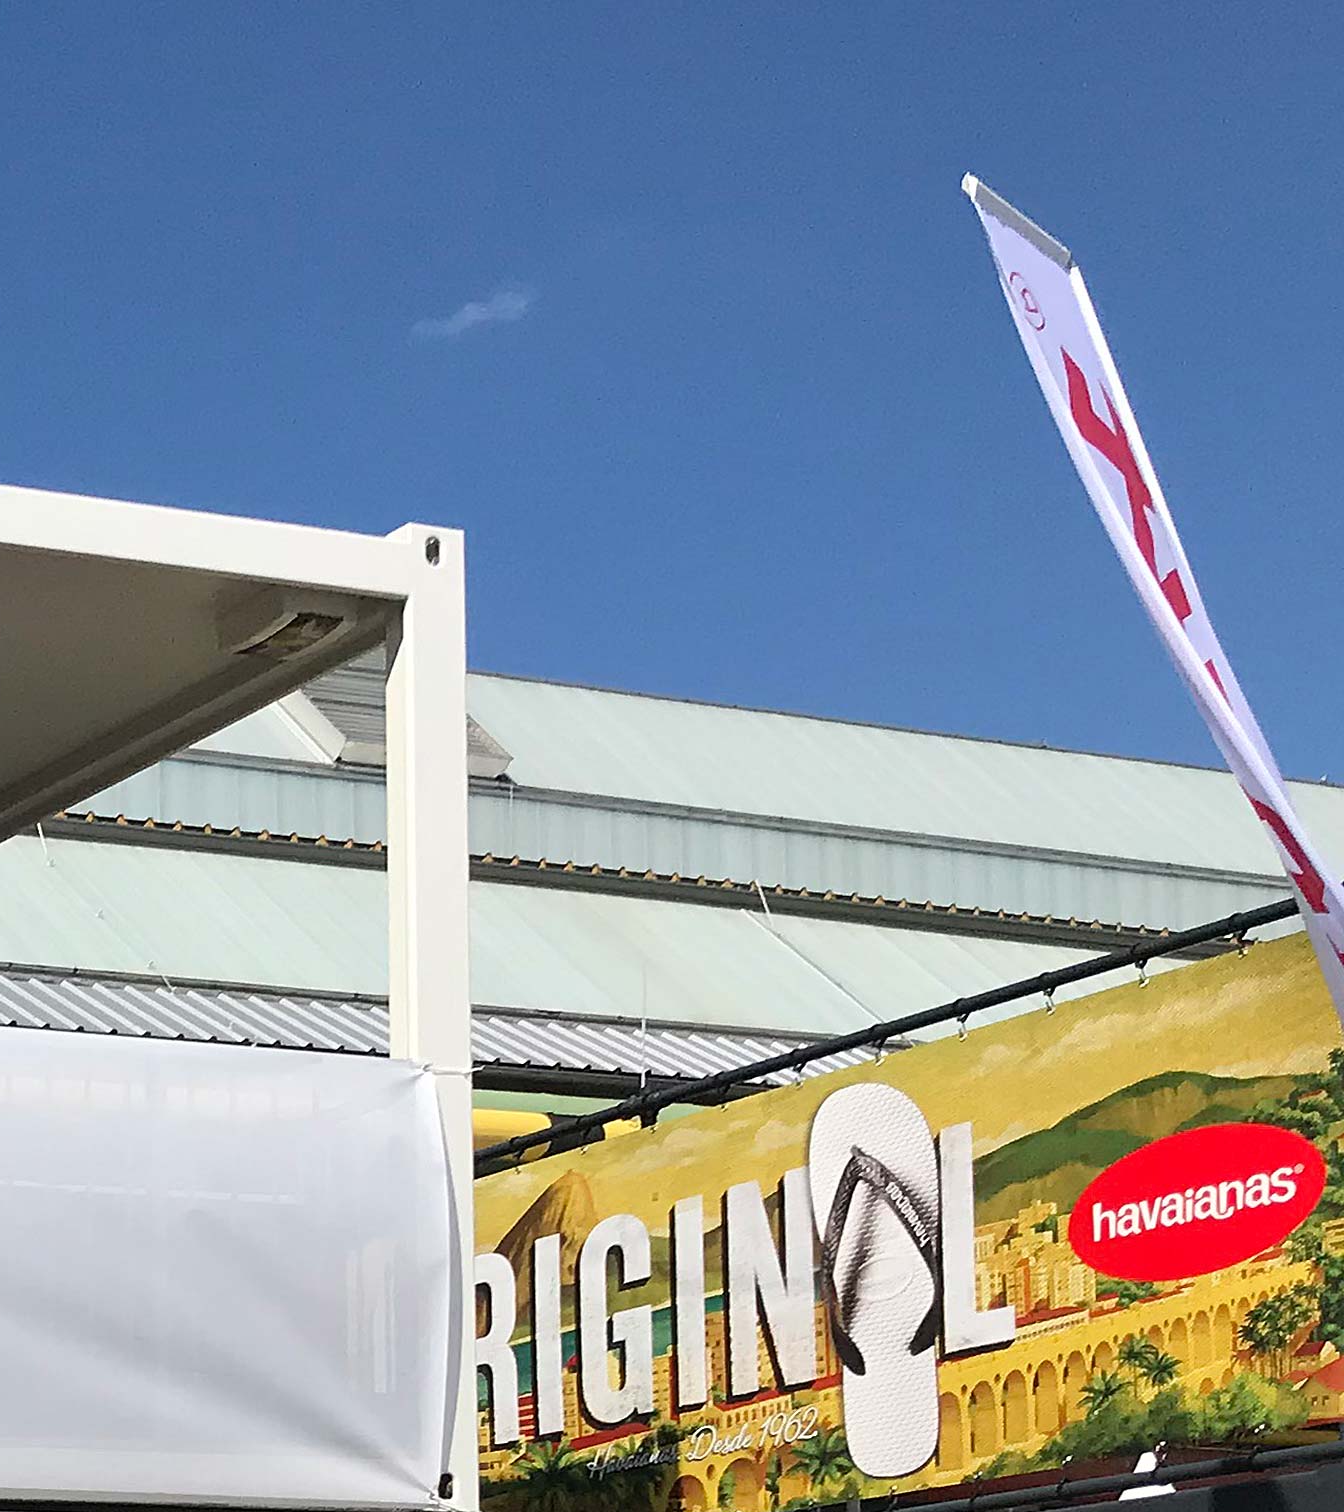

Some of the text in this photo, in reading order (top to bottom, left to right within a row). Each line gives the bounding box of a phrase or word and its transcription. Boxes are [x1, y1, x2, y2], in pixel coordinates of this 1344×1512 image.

[1092, 1165, 1298, 1243] havaianas
[688, 1425, 752, 1463] Desde
[759, 1406, 819, 1446] 1962
